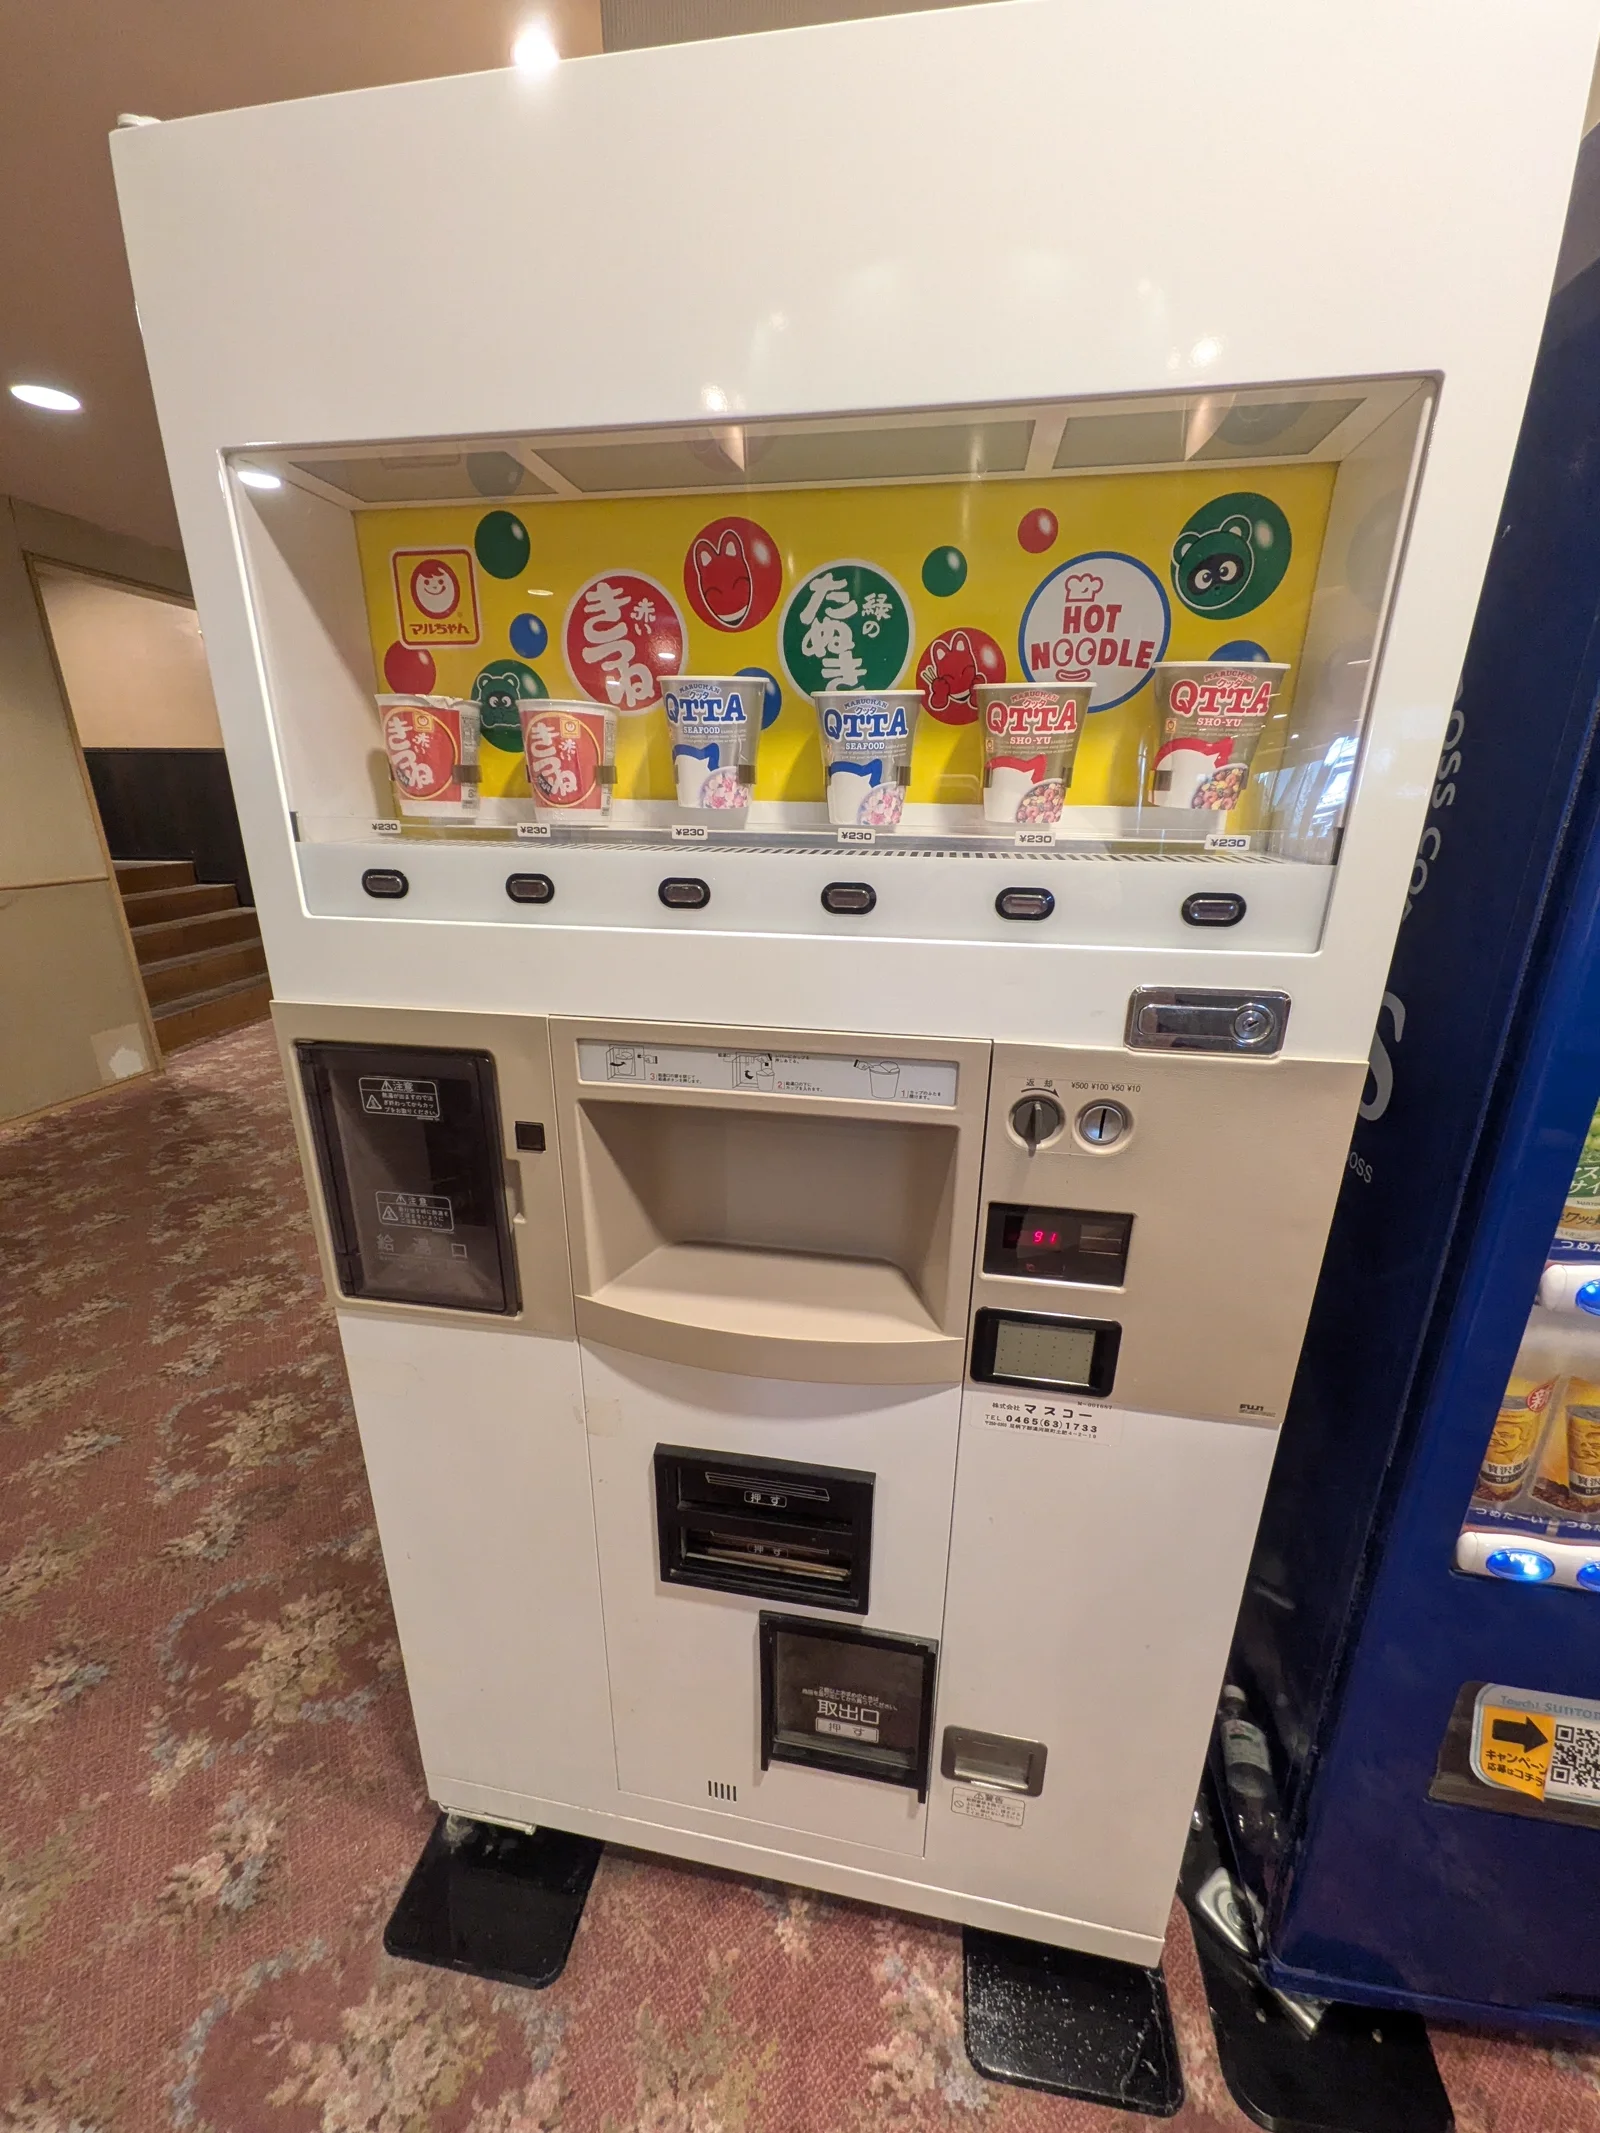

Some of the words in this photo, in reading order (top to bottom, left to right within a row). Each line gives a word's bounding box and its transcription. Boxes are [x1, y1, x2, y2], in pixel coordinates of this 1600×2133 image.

[630, 597, 656, 636] 赤い
[861, 592, 893, 639] 緑の
[1062, 604, 1123, 635] HOT
[409, 623, 470, 635] マルちゃん
[799, 572, 868, 692] たぬき
[582, 582, 655, 708] きつね
[1031, 637, 1156, 671] NOODLE
[679, 683, 721, 694] MARUCHAN
[1216, 678, 1244, 689] クッタ
[689, 690, 709, 700] クッタ
[1169, 679, 1272, 717] QTTA
[665, 692, 748, 725] QTTA
[843, 698, 888, 709] MARUCHAN
[1022, 699, 1047, 709] クッタ
[855, 706, 877, 715] クッタ
[824, 706, 909, 741] QTTA
[986, 699, 1077, 736] QTTA
[1196, 717, 1242, 728] SHO-YU
[683, 726, 721, 735] SEAFOOD
[845, 742, 885, 751] SEAFOOD
[1009, 736, 1052, 745] SHO-YU
[530, 721, 578, 797] きつね
[371, 823, 398, 831] ¥230
[520, 826, 548, 835] ¥230
[675, 828, 705, 836] ¥230
[841, 831, 872, 840] ¥230
[1019, 834, 1053, 844] ¥230
[1210, 838, 1247, 848] ¥230
[777, 1081, 783, 1089] 2
[1026, 1078, 1053, 1088] 返却
[1071, 1081, 1089, 1090] ¥500
[1091, 1083, 1109, 1091] ¥100
[1111, 1084, 1125, 1092] ¥50
[1127, 1085, 1141, 1093] ¥10
[1033, 1230, 1058, 1243] 91
[992, 1402, 1020, 1411] 株式会社
[1024, 1404, 1093, 1419] マスコー
[1006, 1415, 1098, 1433] 0465(63)1733
[750, 1493, 780, 1506] 押す
[817, 1699, 880, 1725] 取出口
[829, 1722, 865, 1737] 押す
[1486, 1749, 1548, 1775] キャンペーン
